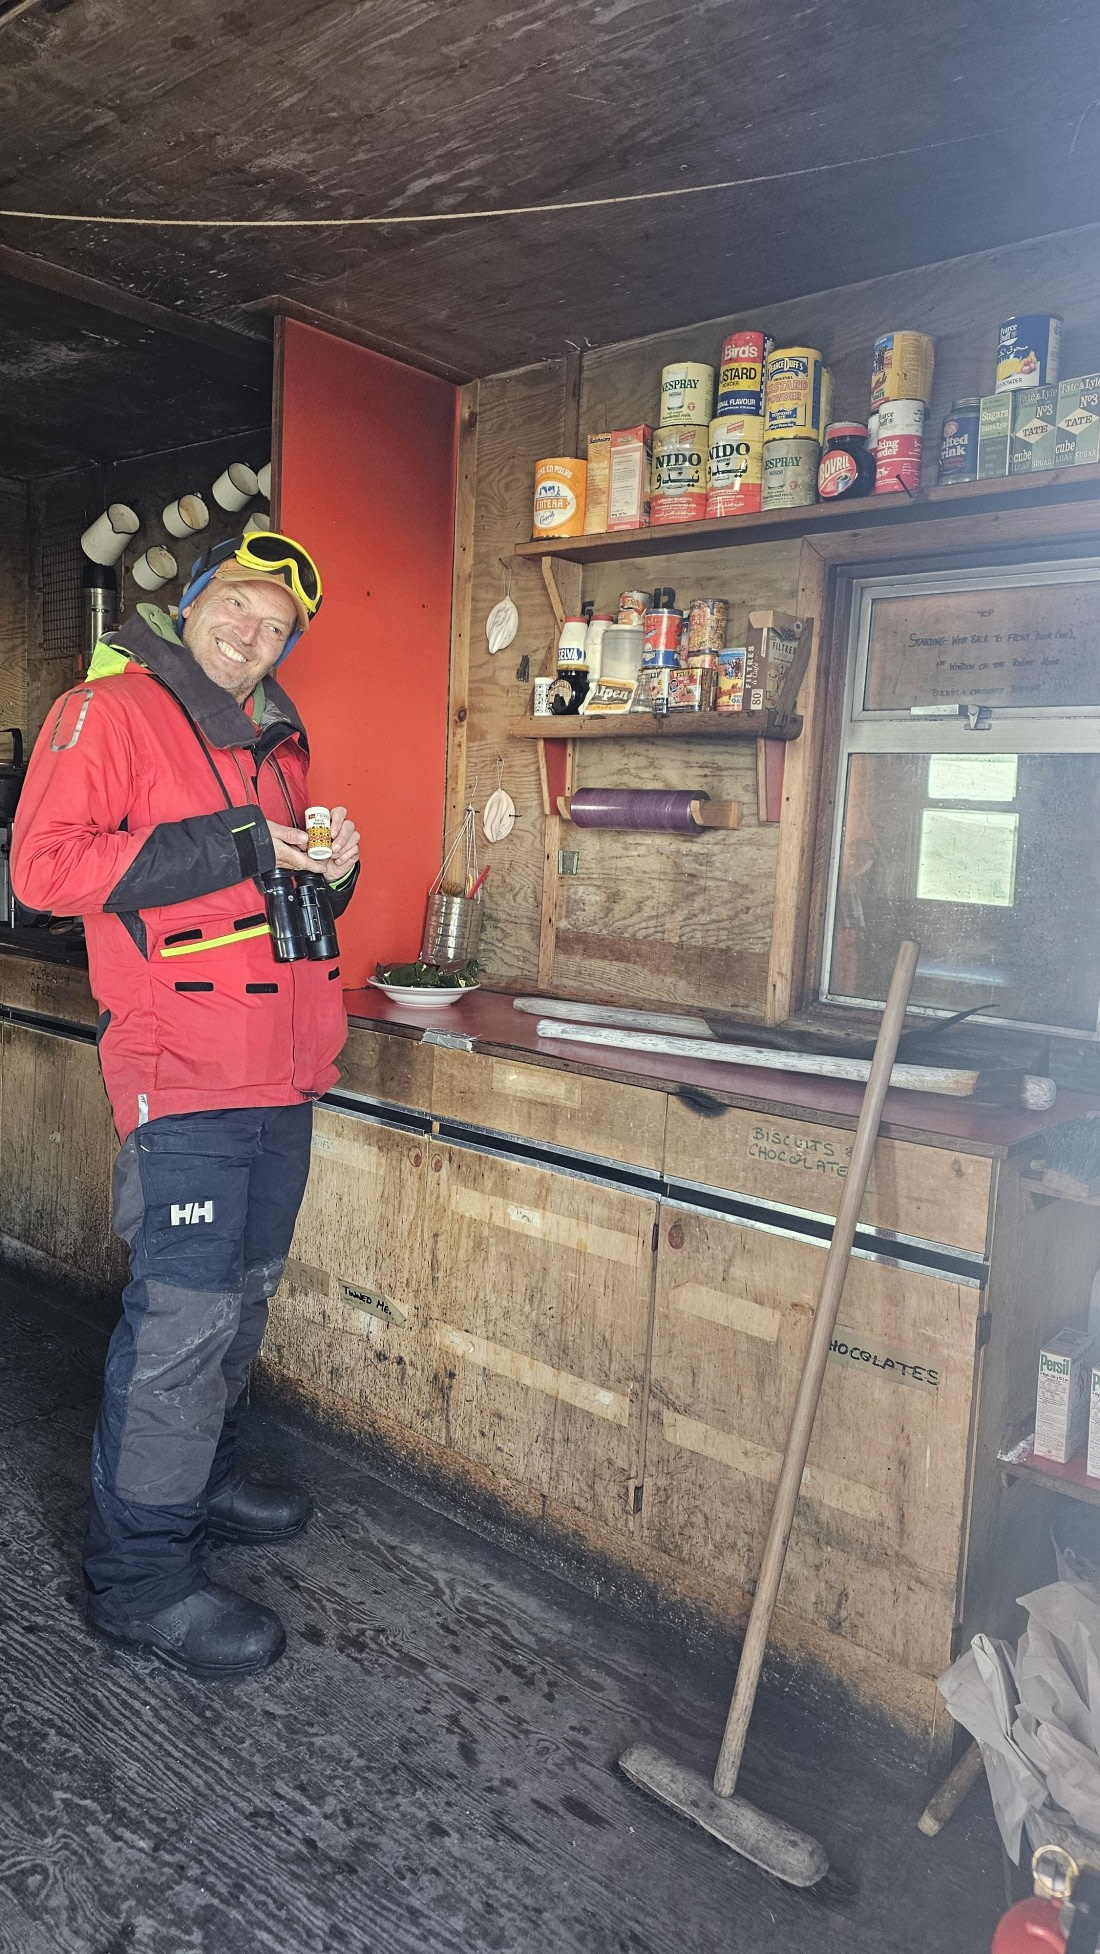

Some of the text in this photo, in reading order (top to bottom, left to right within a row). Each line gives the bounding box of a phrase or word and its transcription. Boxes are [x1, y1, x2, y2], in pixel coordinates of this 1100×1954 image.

[724, 342, 758, 360] Bird's
[720, 368, 757, 384] USTARD
[768, 380, 808, 392] USTARD
[880, 410, 894, 420] earce
[982, 410, 1009, 421] Sugars
[1065, 414, 1093, 428] TATE
[1022, 425, 1048, 437] TATE
[878, 440, 900, 449] king
[1056, 440, 1075, 454] cube
[941, 446, 966, 460] rink
[1014, 450, 1032, 463] cube
[1075, 448, 1097, 459] SUGAR
[655, 453, 702, 470] NIDO
[764, 456, 802, 470] ESPRAY
[820, 456, 850, 480] BOVRIL
[554, 466, 573, 478] POLVO
[536, 498, 563, 510] ENTERA
[978, 609, 994, 618] TOP
[772, 642, 796, 655] FILTRES
[745, 645, 755, 688] FILTRES
[752, 693, 762, 705] 80
[752, 1126, 835, 1156] BISCUITS
[170, 1200, 213, 1226] HH
[342, 1285, 391, 1316] TINNED ME
[829, 1340, 939, 1385] HOCOLATES
[1040, 1354, 1069, 1376] Persil
